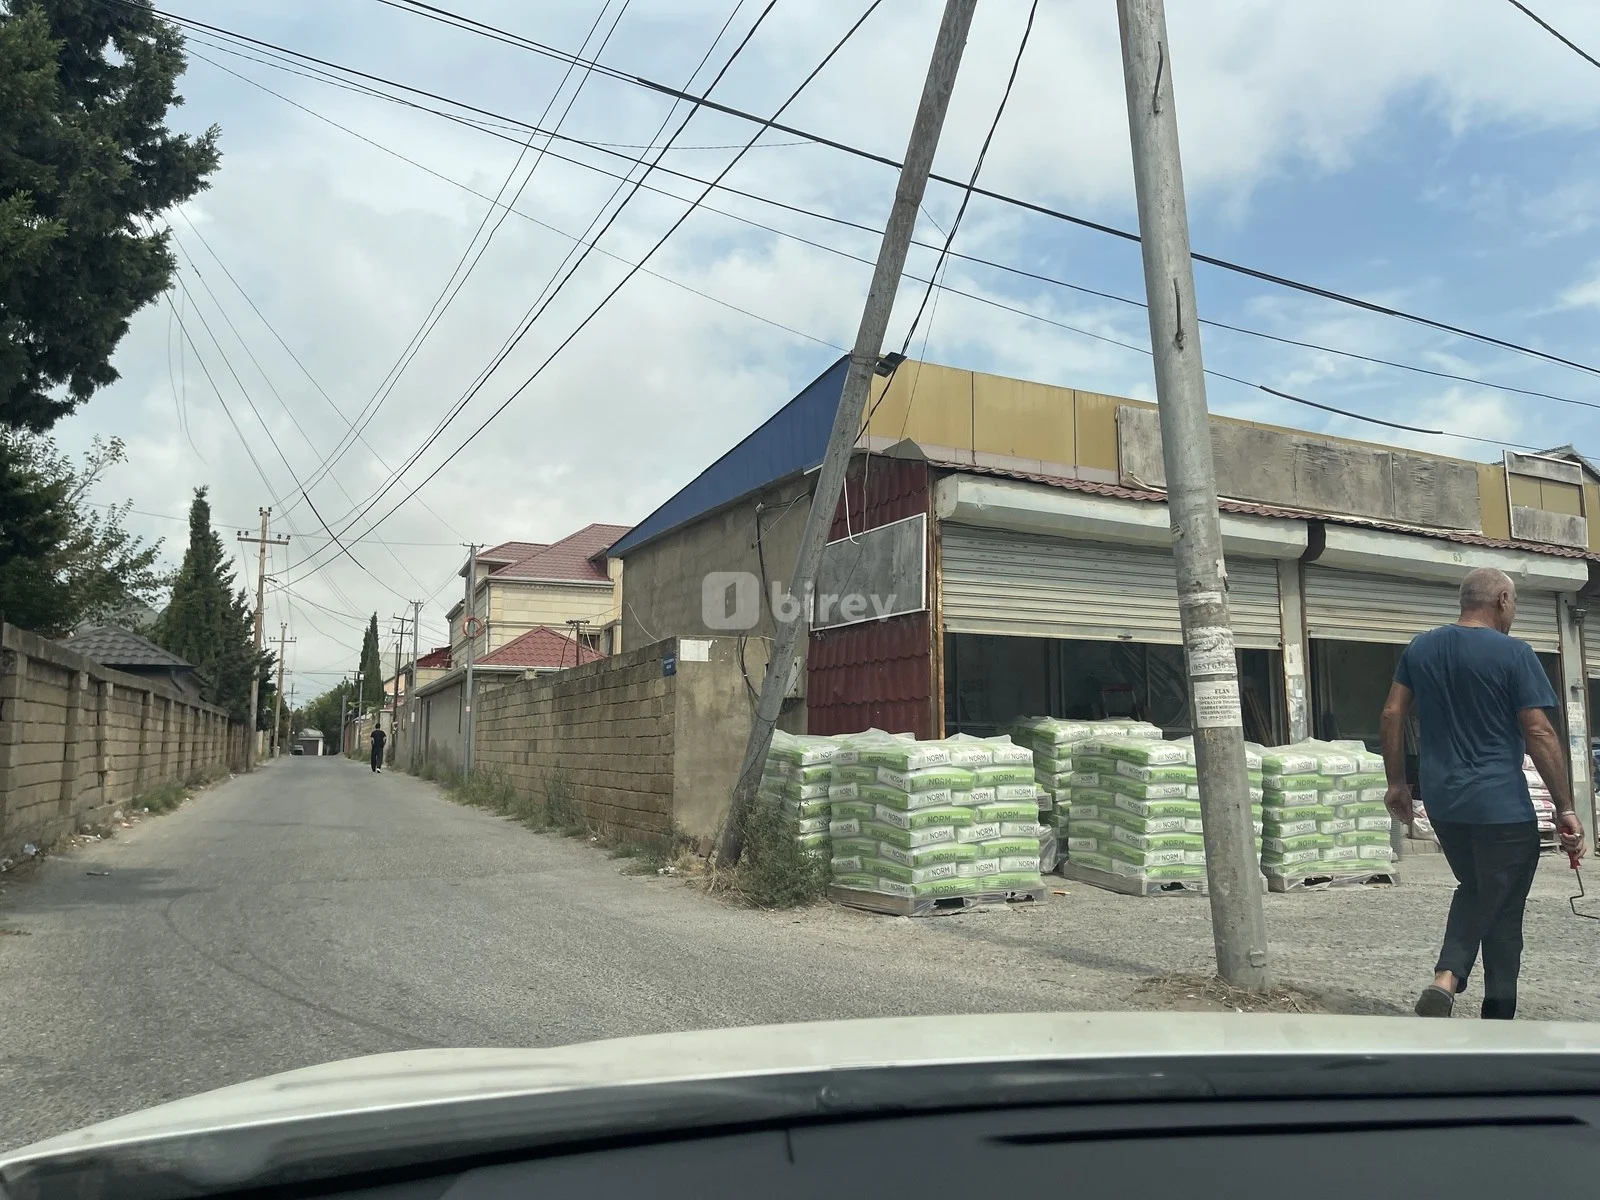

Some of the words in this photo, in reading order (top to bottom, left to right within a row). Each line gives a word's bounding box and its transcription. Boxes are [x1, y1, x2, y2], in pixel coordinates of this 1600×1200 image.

[926, 753, 944, 762] NORM
[1128, 767, 1142, 777] NORM
[928, 778, 951, 786] NORM
[992, 774, 1015, 782] NORM
[926, 793, 945, 801] NORM
[970, 792, 988, 800] NORM
[1163, 806, 1185, 814] NORM
[996, 811, 1018, 819] NORM
[927, 816, 951, 824] NORM
[1296, 823, 1311, 831] NORM
[929, 830, 948, 839] NORM
[975, 827, 993, 837] NORM
[999, 846, 1020, 854] NORM
[892, 849, 907, 861] NORM
[933, 853, 956, 861] NORM
[975, 862, 993, 871] NORM
[1018, 860, 1035, 868] NORM
[931, 867, 950, 876] NORM
[890, 882, 905, 893] NORM
[931, 886, 956, 894] NORM
